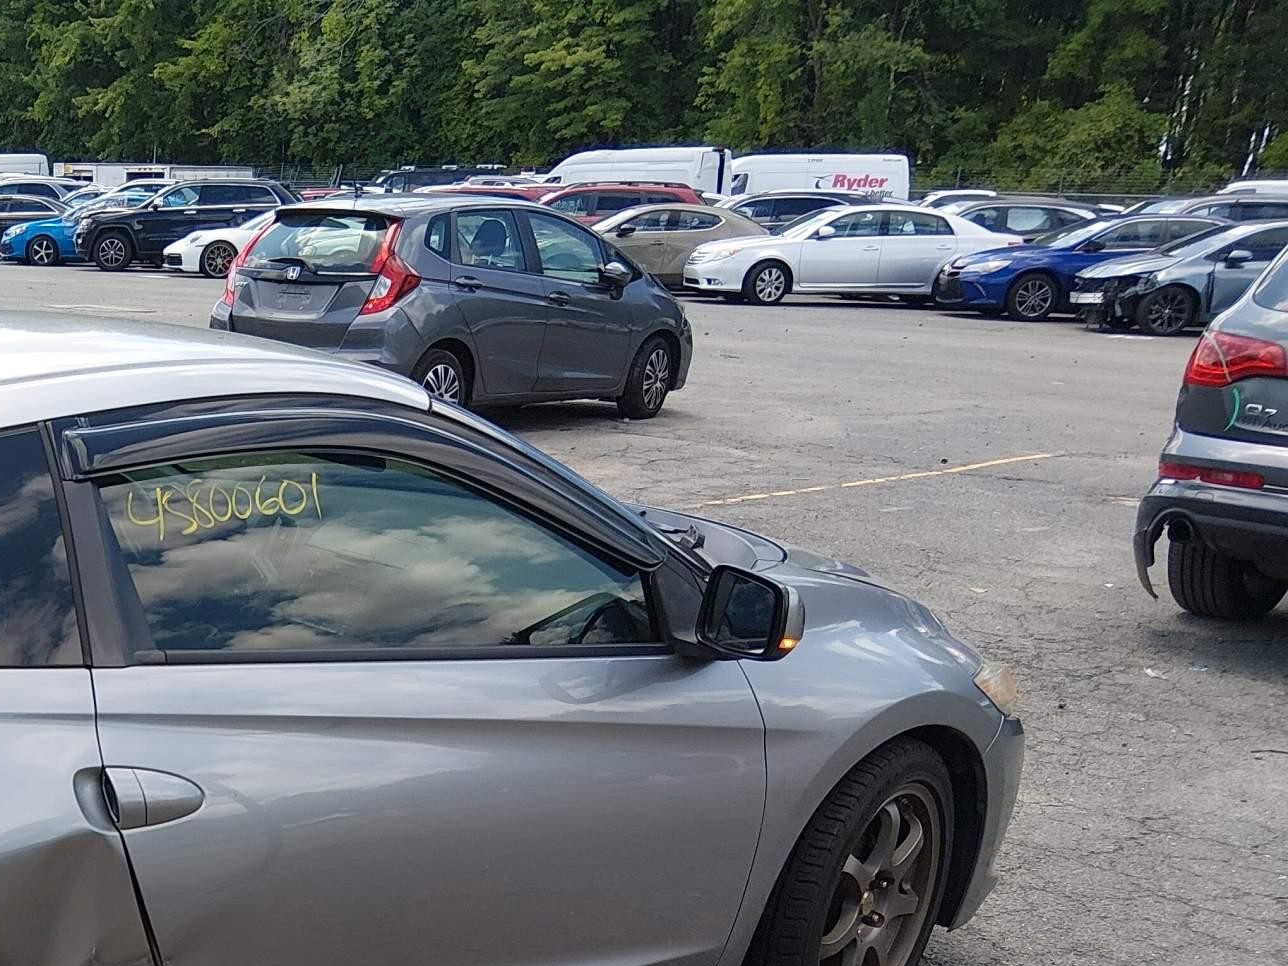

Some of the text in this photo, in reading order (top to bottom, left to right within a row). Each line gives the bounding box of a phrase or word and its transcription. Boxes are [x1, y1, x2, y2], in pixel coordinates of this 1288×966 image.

[832, 174, 888, 190] Ryder
[1245, 403, 1278, 418] Q7
[127, 472, 322, 541] 45800601
